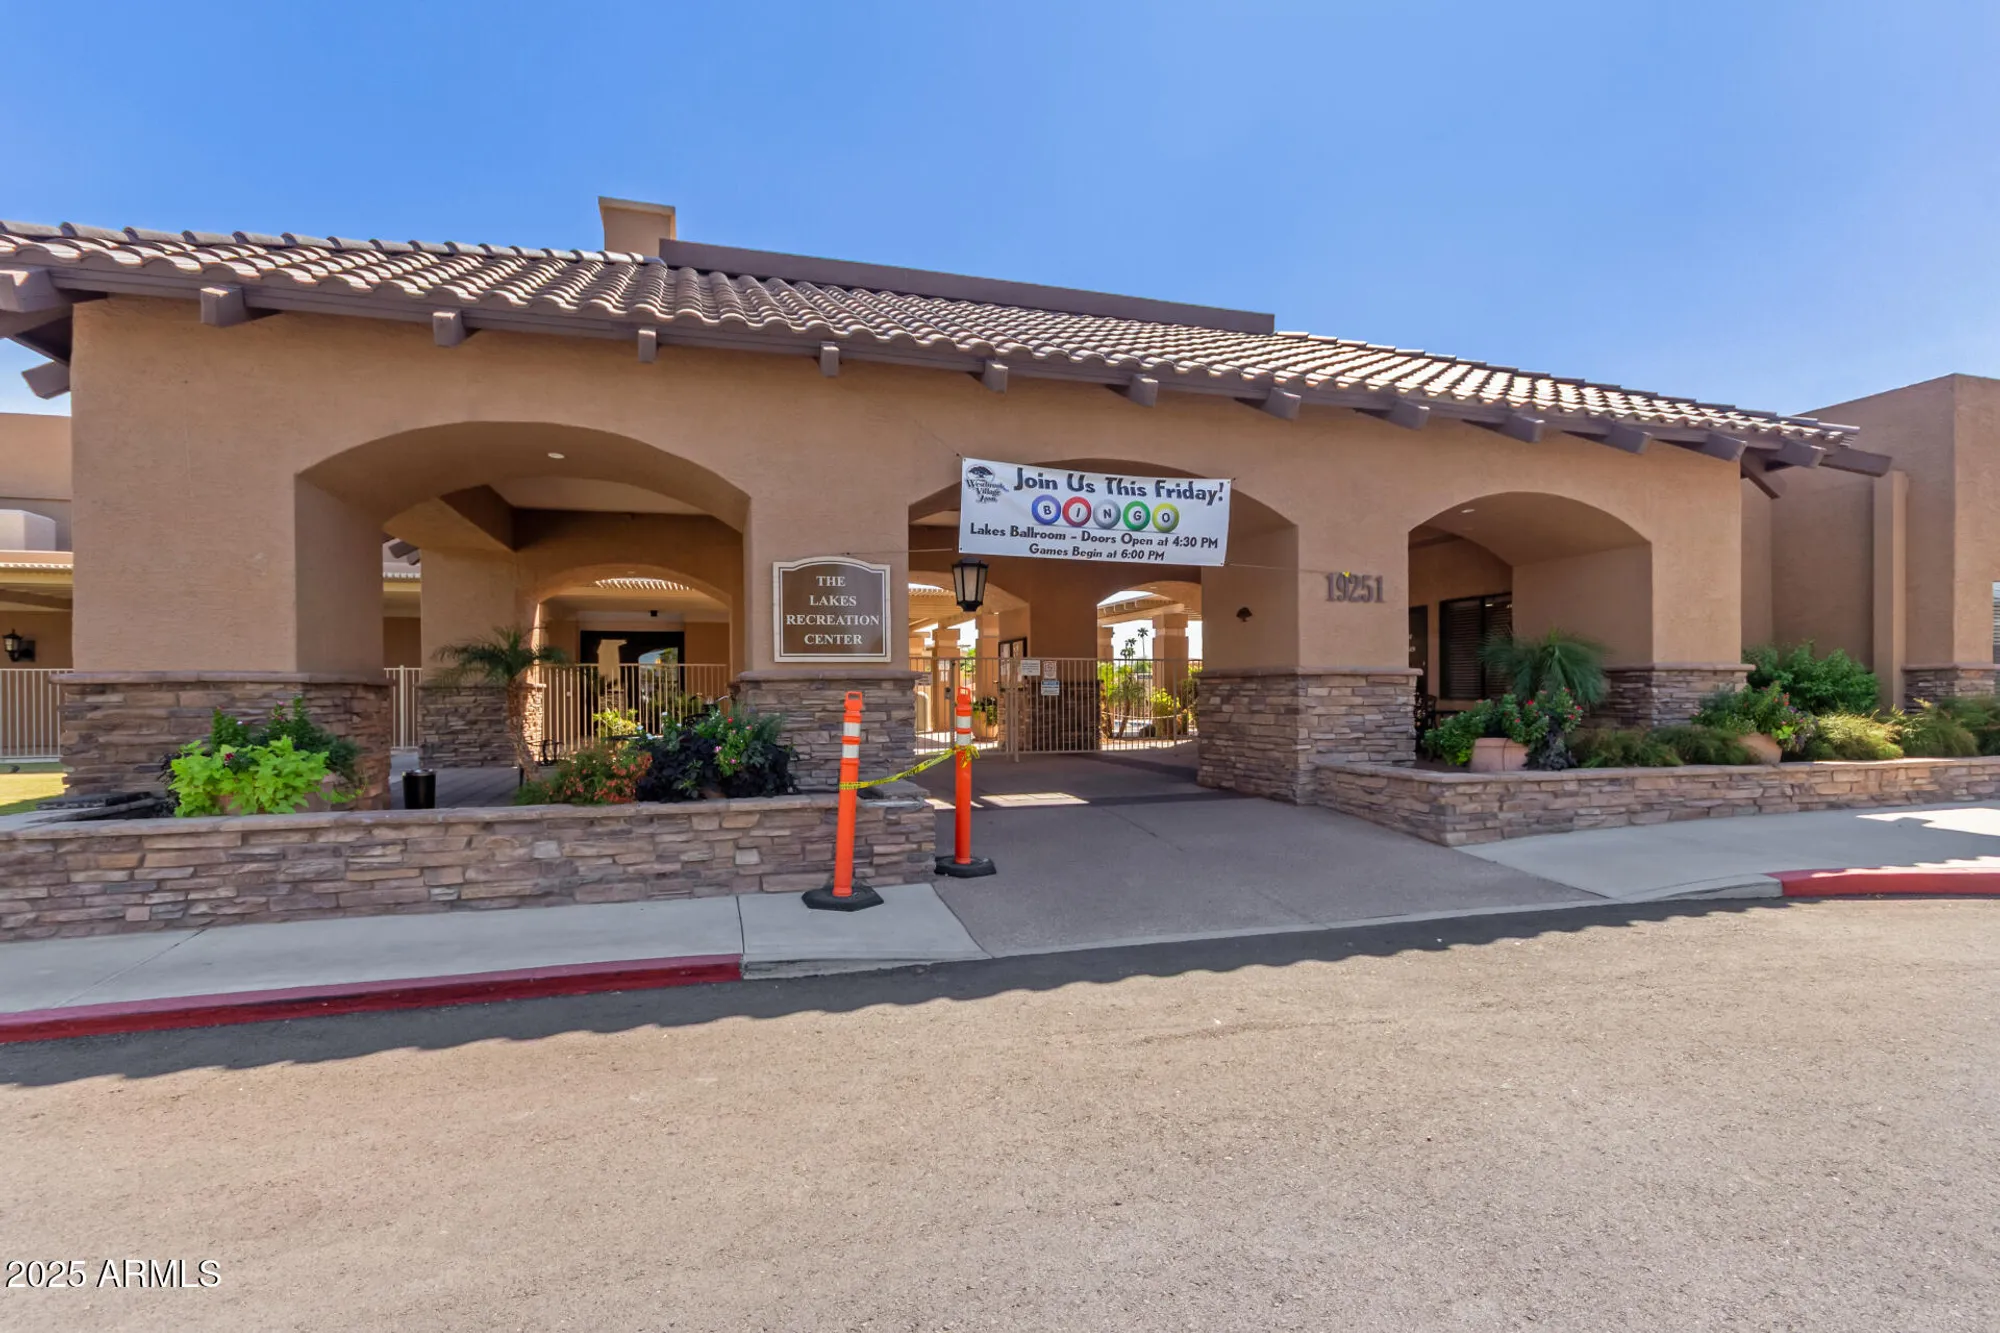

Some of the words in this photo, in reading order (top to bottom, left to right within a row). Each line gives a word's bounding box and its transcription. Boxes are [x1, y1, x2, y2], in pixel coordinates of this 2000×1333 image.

[1013, 467, 1058, 490] Join
[1066, 473, 1096, 493] Us
[1105, 477, 1147, 497] This
[1154, 479, 1224, 506] Friday!
[970, 522, 1006, 537] Lakes
[1010, 525, 1066, 541] Ballroom
[1081, 530, 1116, 544] Doors
[1120, 532, 1153, 547] Open
[1157, 536, 1168, 546] at
[1172, 536, 1197, 548] 4:30
[1200, 537, 1218, 548] PM
[1028, 543, 1068, 556] Games
[1072, 546, 1102, 559] Begin
[1106, 549, 1117, 559] at
[1120, 548, 1145, 559] 6:00
[1147, 550, 1165, 561] PM
[816, 575, 846, 587] THE
[1325, 571, 1387, 604] 19251
[809, 594, 857, 607] LAKES
[786, 614, 880, 626] RECREATION
[804, 633, 863, 645] CENTER
